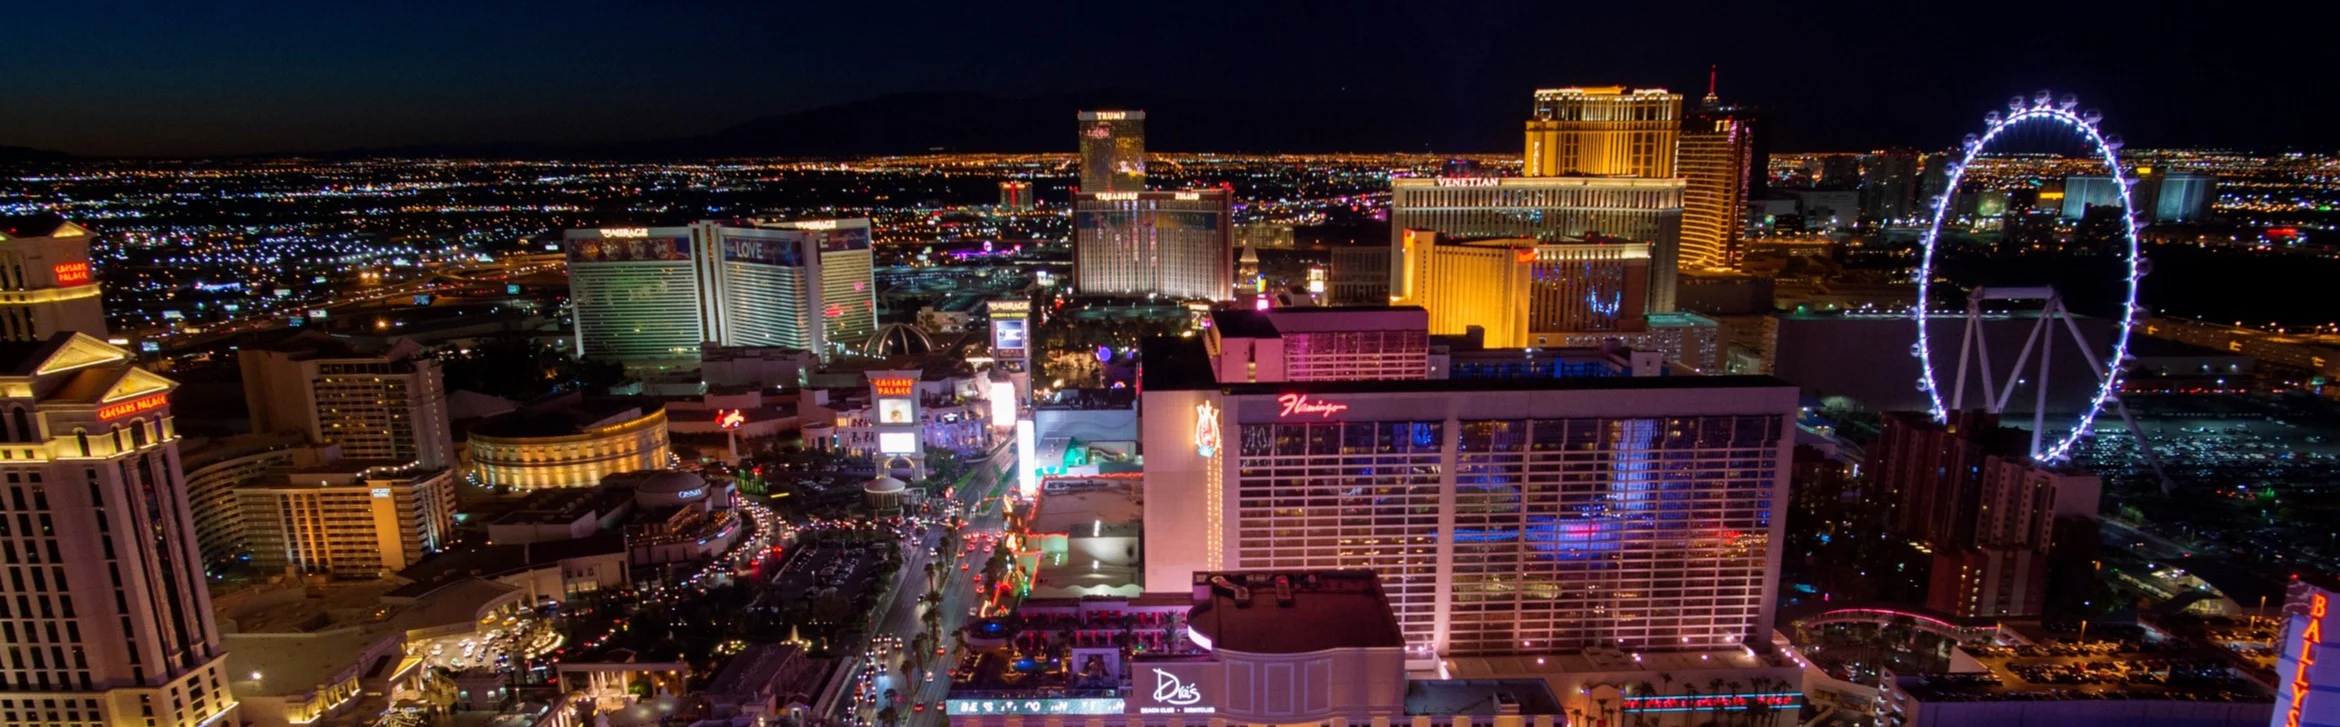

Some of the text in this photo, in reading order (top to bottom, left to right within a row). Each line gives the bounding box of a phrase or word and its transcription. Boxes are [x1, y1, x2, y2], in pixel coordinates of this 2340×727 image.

[1096, 111, 1126, 120] TRUMP
[1437, 177, 1499, 187] VENETIAN
[1095, 192, 1200, 200] TREASURE ISLAND
[611, 227, 648, 238] MIRAGE
[735, 241, 764, 259] LOVE
[55, 262, 87, 273] CAESARS
[58, 270, 88, 281] PALACE
[875, 379, 912, 387] CAESARS
[877, 387, 912, 395] PALACE
[99, 394, 166, 419] CAESARS PALACE
[1278, 393, 1347, 417] Flamingo
